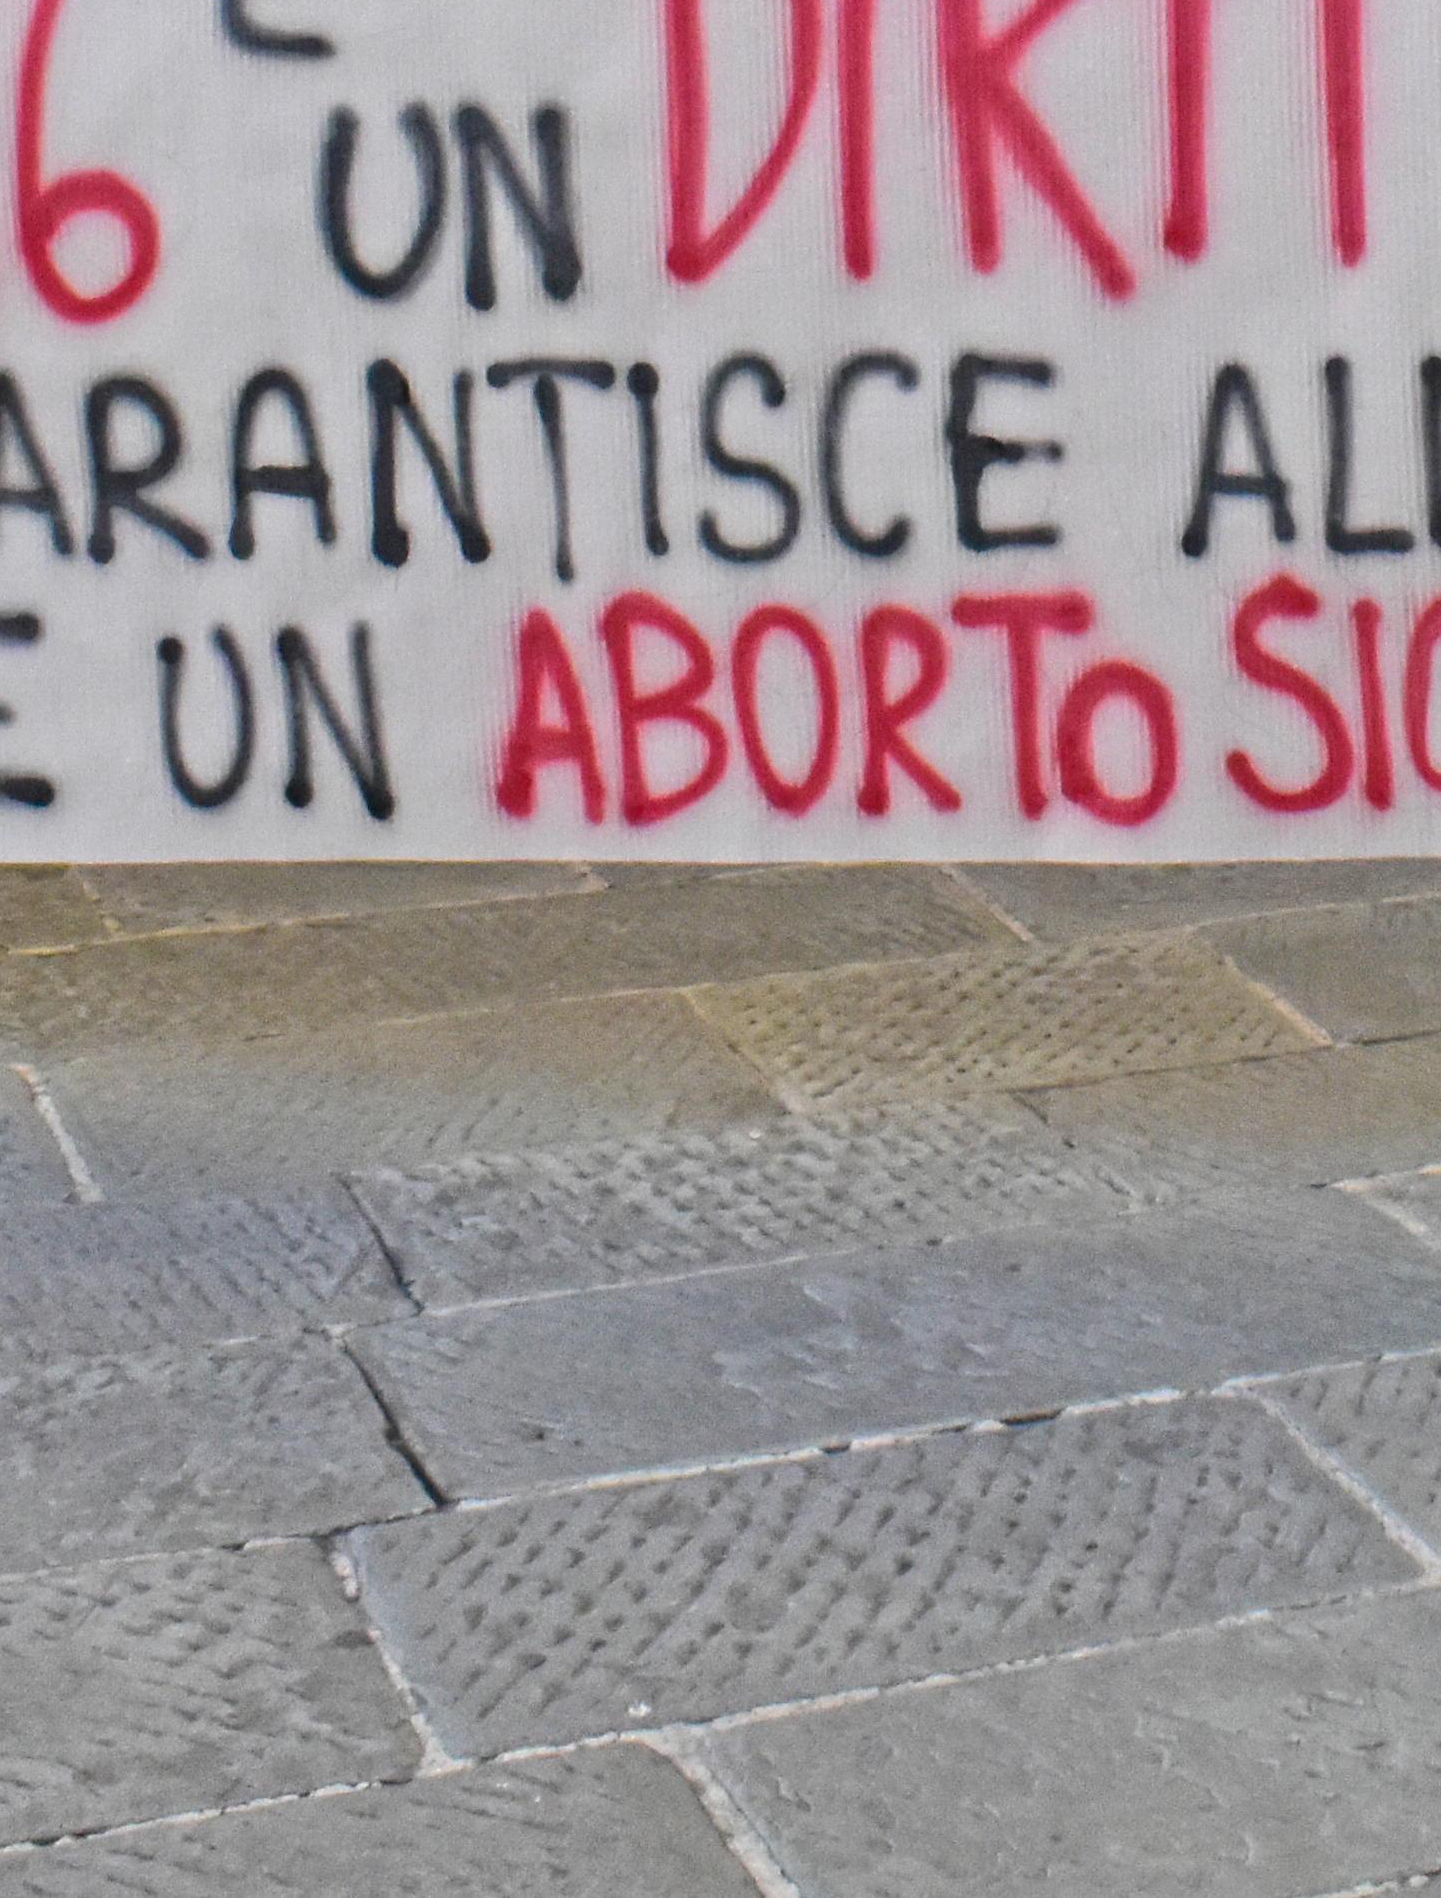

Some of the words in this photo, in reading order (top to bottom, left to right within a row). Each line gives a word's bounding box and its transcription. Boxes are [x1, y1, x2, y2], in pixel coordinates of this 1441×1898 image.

[313, 100, 587, 314] UN
[151, 617, 401, 826] UN
[487, 578, 1189, 832] ABORTO
